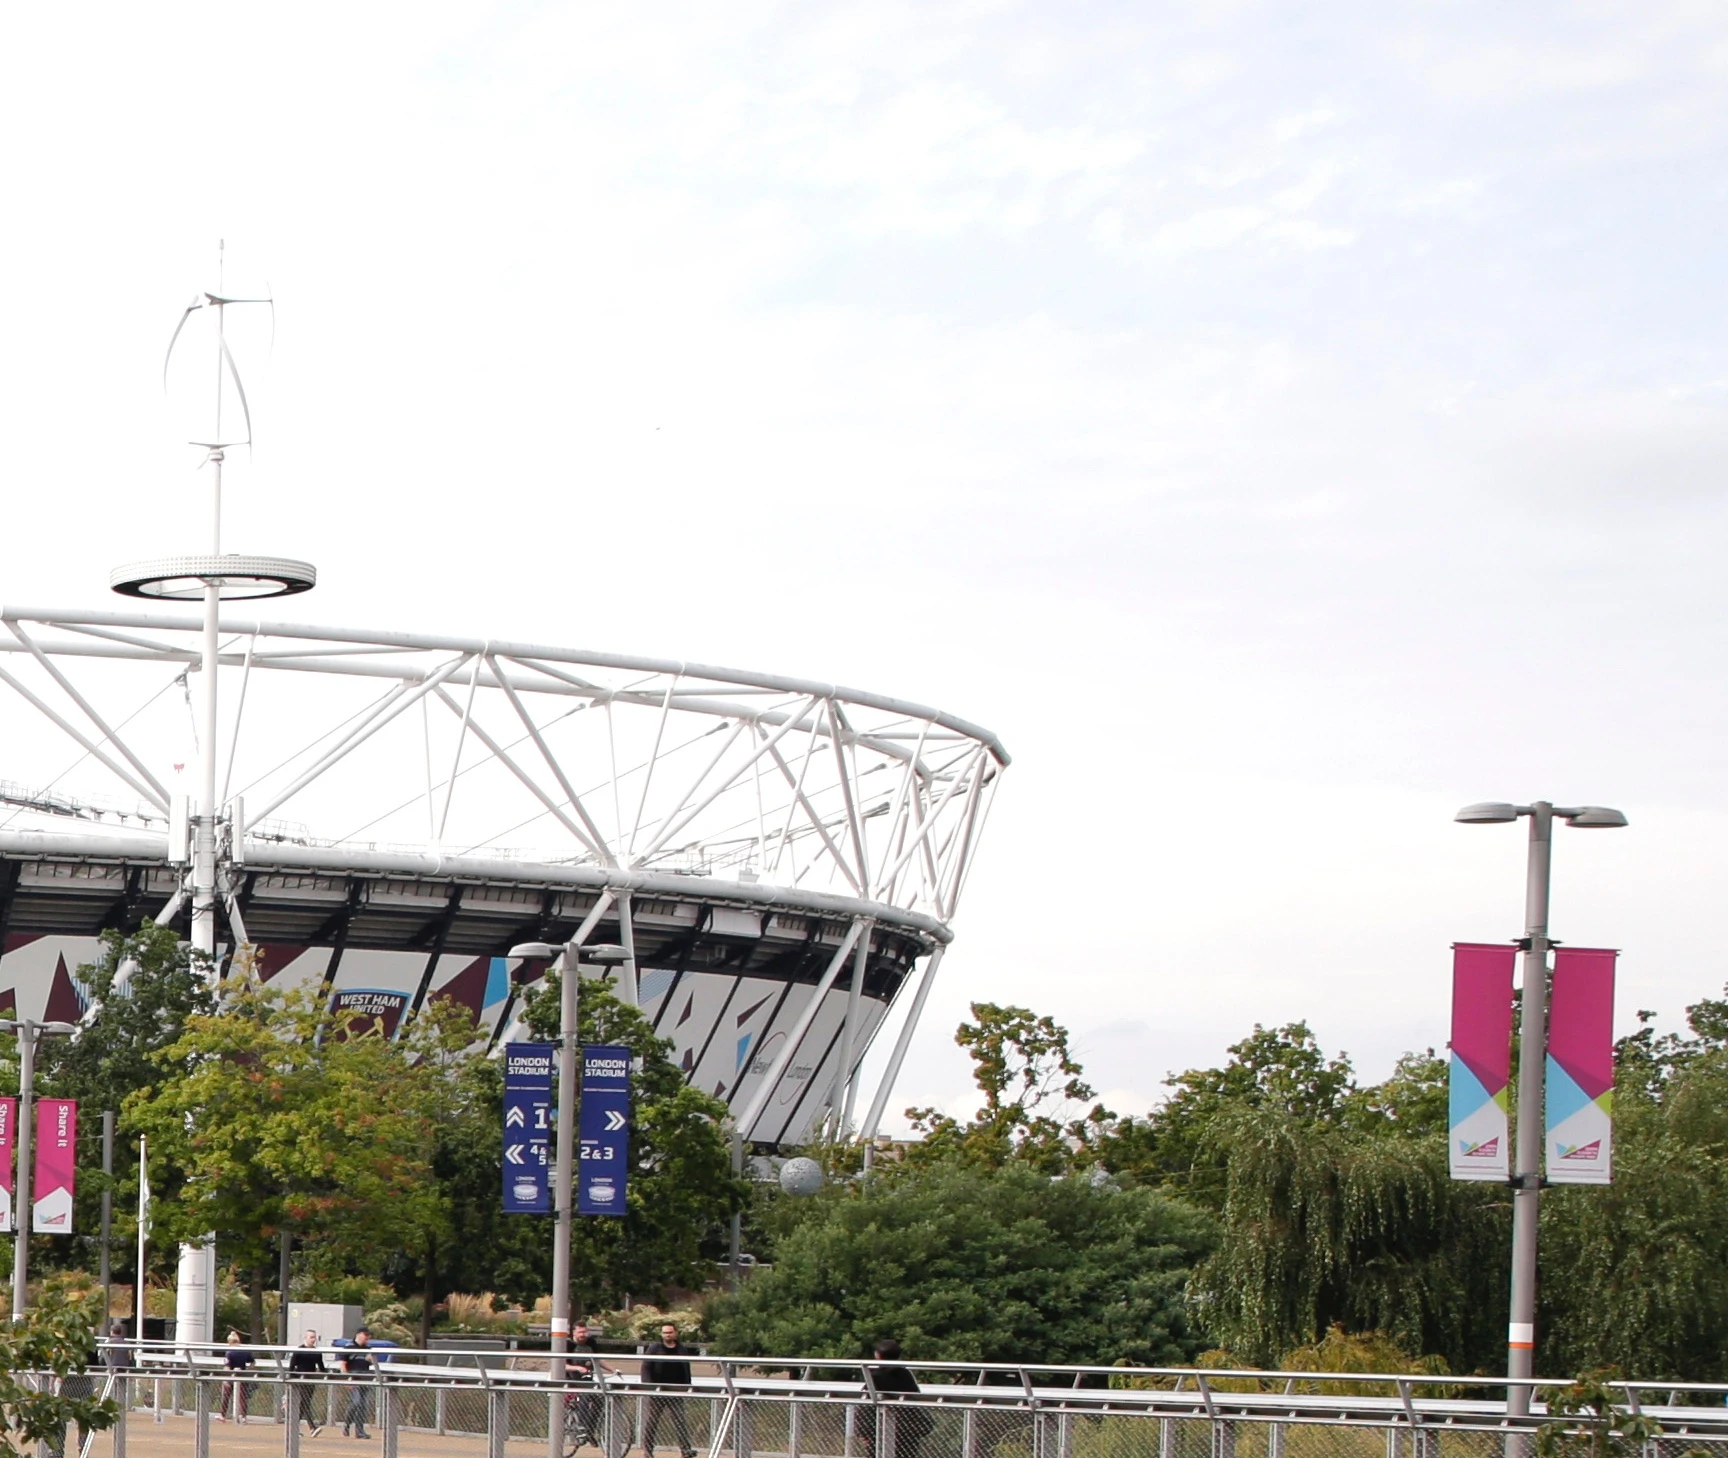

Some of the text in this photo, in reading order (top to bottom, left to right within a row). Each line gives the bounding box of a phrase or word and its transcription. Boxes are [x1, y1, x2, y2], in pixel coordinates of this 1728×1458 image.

[339, 994, 400, 1008] WEST HAM
[508, 1057, 549, 1066] LONDON
[585, 1059, 626, 1068] LONDON
[508, 1066, 549, 1075] STADIUM
[585, 1068, 625, 1077] STADIUM
[58, 1105, 68, 1137] Share
[534, 1108, 547, 1129] 1
